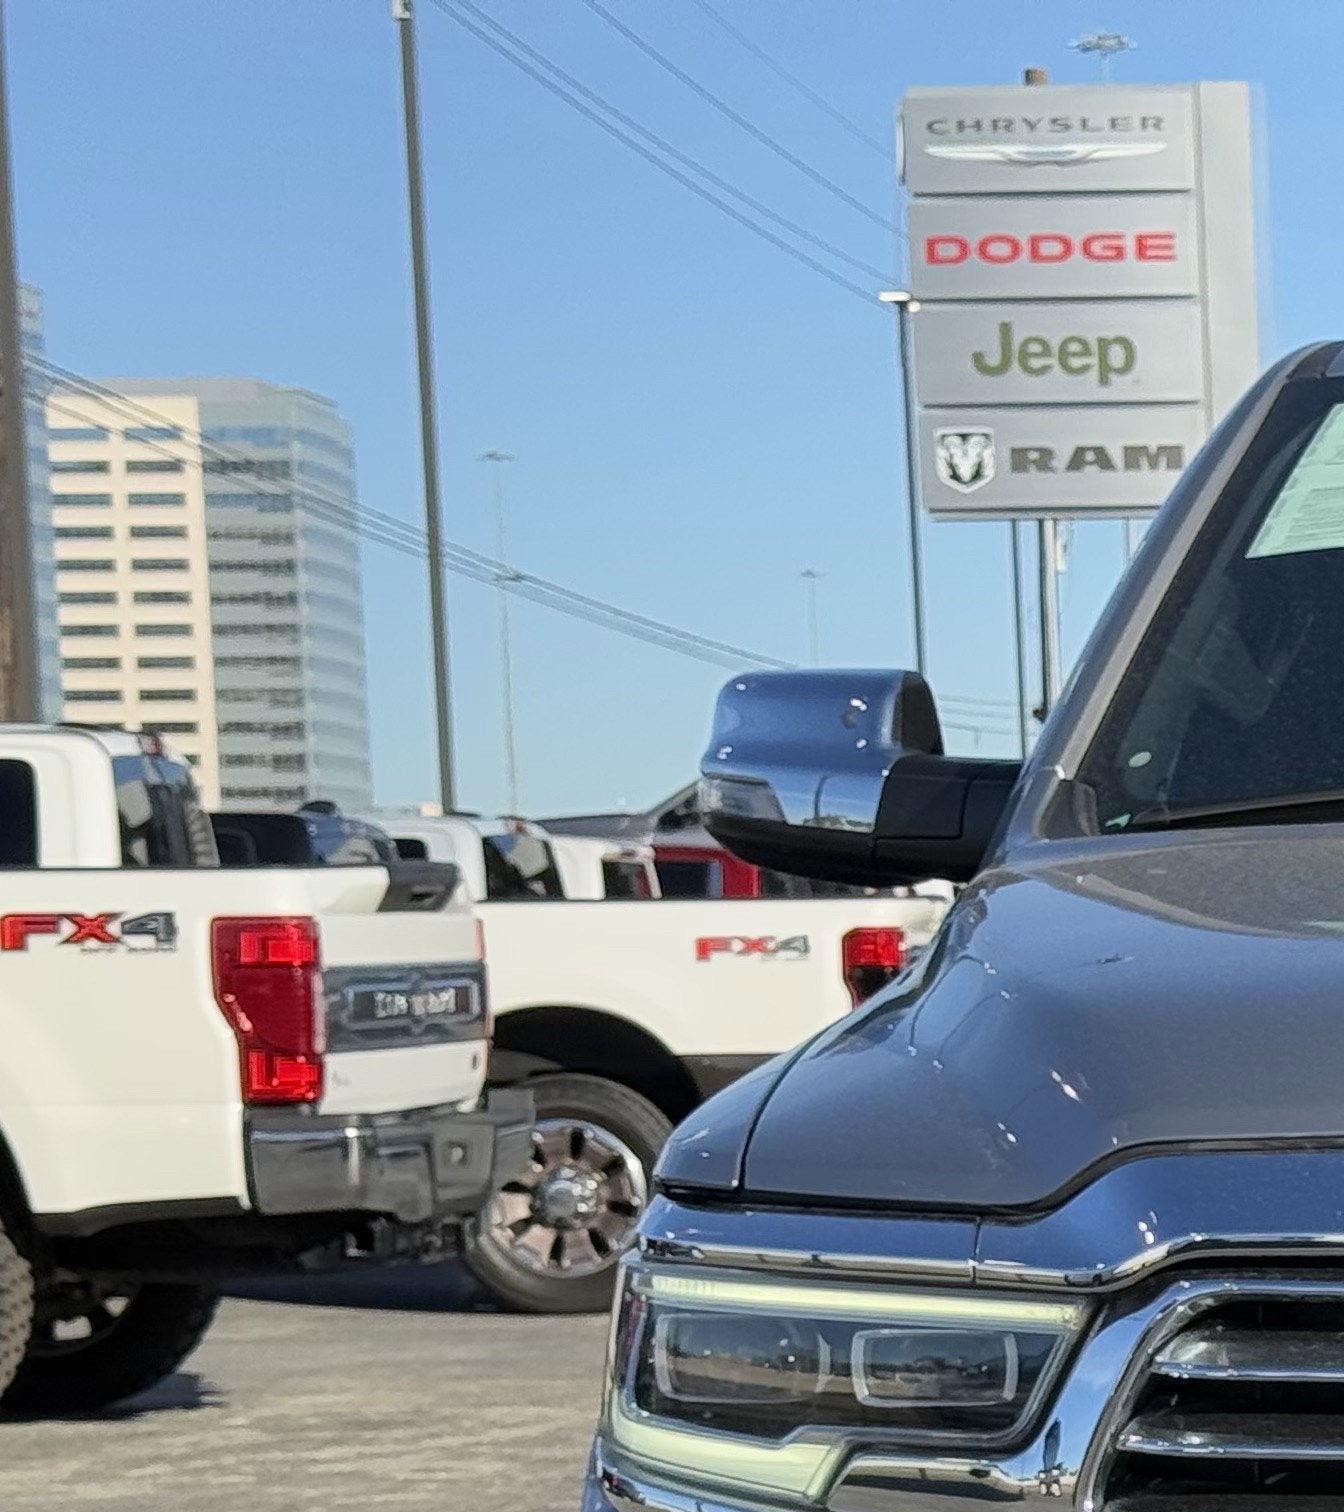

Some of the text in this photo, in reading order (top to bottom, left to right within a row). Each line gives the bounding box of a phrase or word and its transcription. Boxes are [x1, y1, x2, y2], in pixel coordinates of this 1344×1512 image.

[925, 115, 1166, 135] CHRYSLER
[925, 231, 1177, 265] DODGE
[971, 320, 1137, 387] Jeep
[1009, 445, 1184, 473] RAM
[0, 910, 177, 952] FX4
[695, 935, 811, 962] FX4
